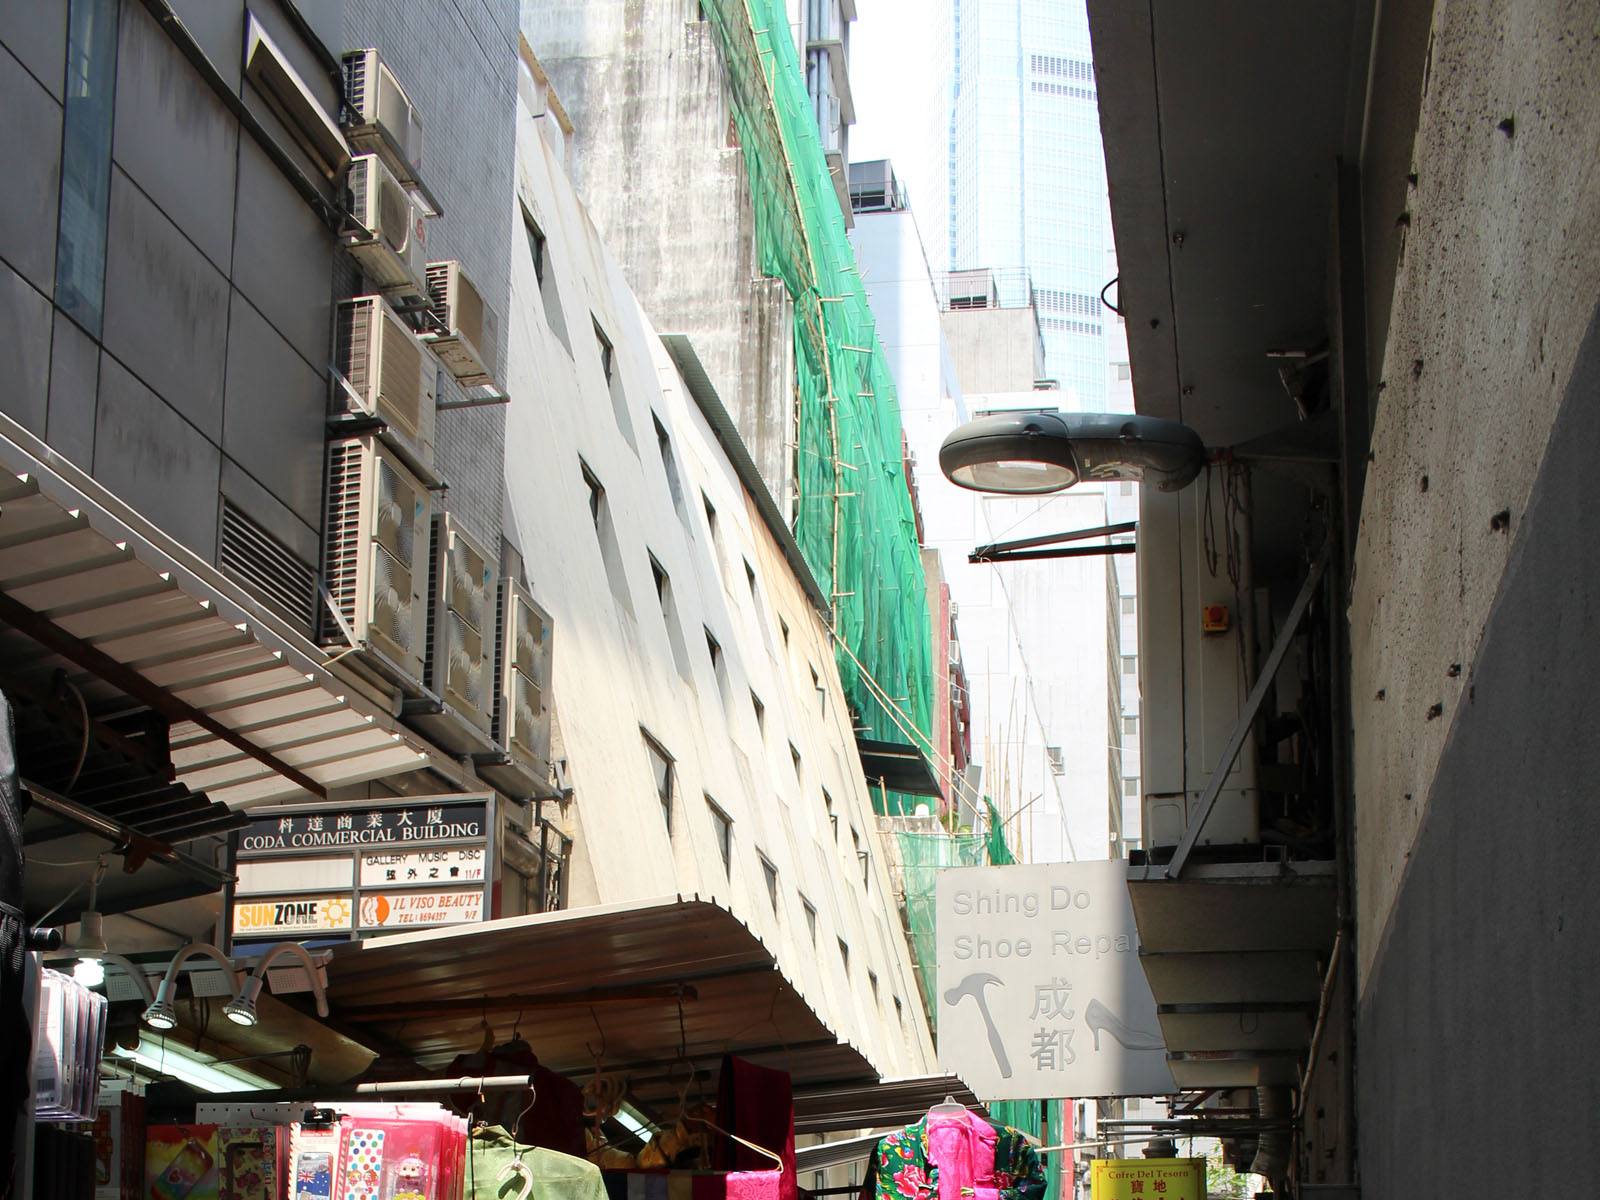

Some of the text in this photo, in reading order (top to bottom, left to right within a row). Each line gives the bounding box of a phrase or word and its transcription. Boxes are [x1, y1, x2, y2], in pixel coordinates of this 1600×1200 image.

[278, 807, 444, 834] 科達商業大廈
[243, 822, 479, 851] CODA COMMERCIAL BUILDING
[366, 849, 481, 866] GALLERY MUSIC DISC
[409, 896, 435, 909] VISO
[438, 893, 482, 908] BEAUTY
[952, 885, 1091, 918] Shing Do
[953, 932, 1032, 960] Shoe
[1108, 1170, 1136, 1180] Cofre
[1137, 1170, 1154, 1178] Del
